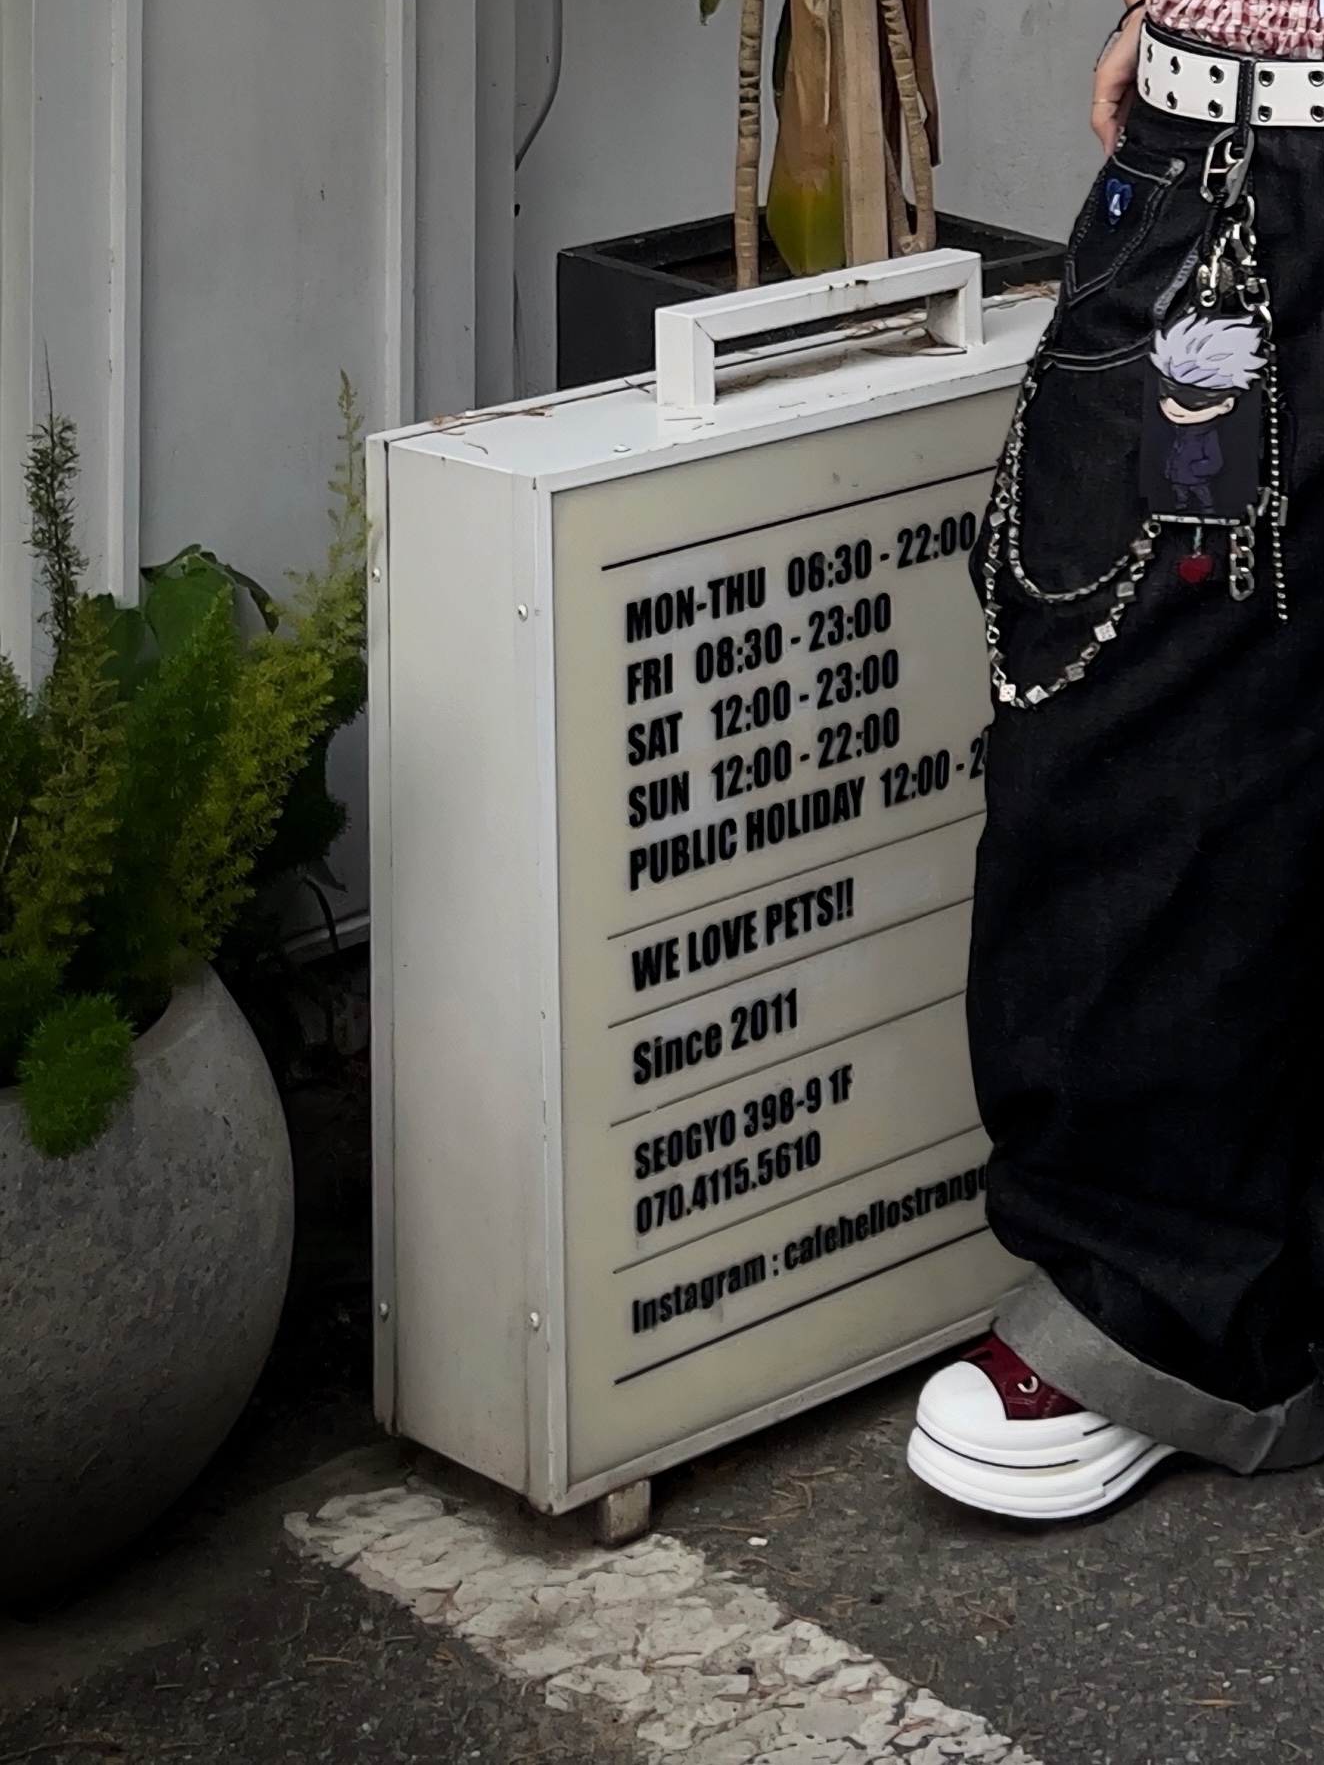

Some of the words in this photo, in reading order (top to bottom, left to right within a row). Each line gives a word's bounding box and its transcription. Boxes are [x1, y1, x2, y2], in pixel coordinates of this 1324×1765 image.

[626, 567, 766, 643] MON-THU
[897, 512, 977, 569] 22:00
[626, 653, 674, 705] FRI
[695, 622, 783, 684] 08:30
[808, 592, 892, 653] 23:00
[627, 712, 683, 767] SAT
[710, 680, 791, 741] 12:00
[816, 648, 899, 710] 23:00
[628, 771, 690, 829] SUN
[710, 740, 792, 802] 12:00
[818, 707, 900, 770] 22:00
[629, 818, 738, 892] PUBLIC
[746, 776, 866, 852] HOLIDAY
[881, 750, 951, 808] 12:00
[631, 938, 680, 992] WE
[687, 911, 757, 972] LOVE
[765, 877, 855, 947] PETS!!
[633, 1023, 722, 1085] Since
[731, 988, 798, 1051] 2011
[634, 1114, 736, 1180] SEOGYO
[744, 1077, 822, 1137] 398-9
[828, 1064, 854, 1104] 1F
[636, 1130, 822, 1235] 070.4115.5610
[631, 1253, 767, 1335] Instagram
